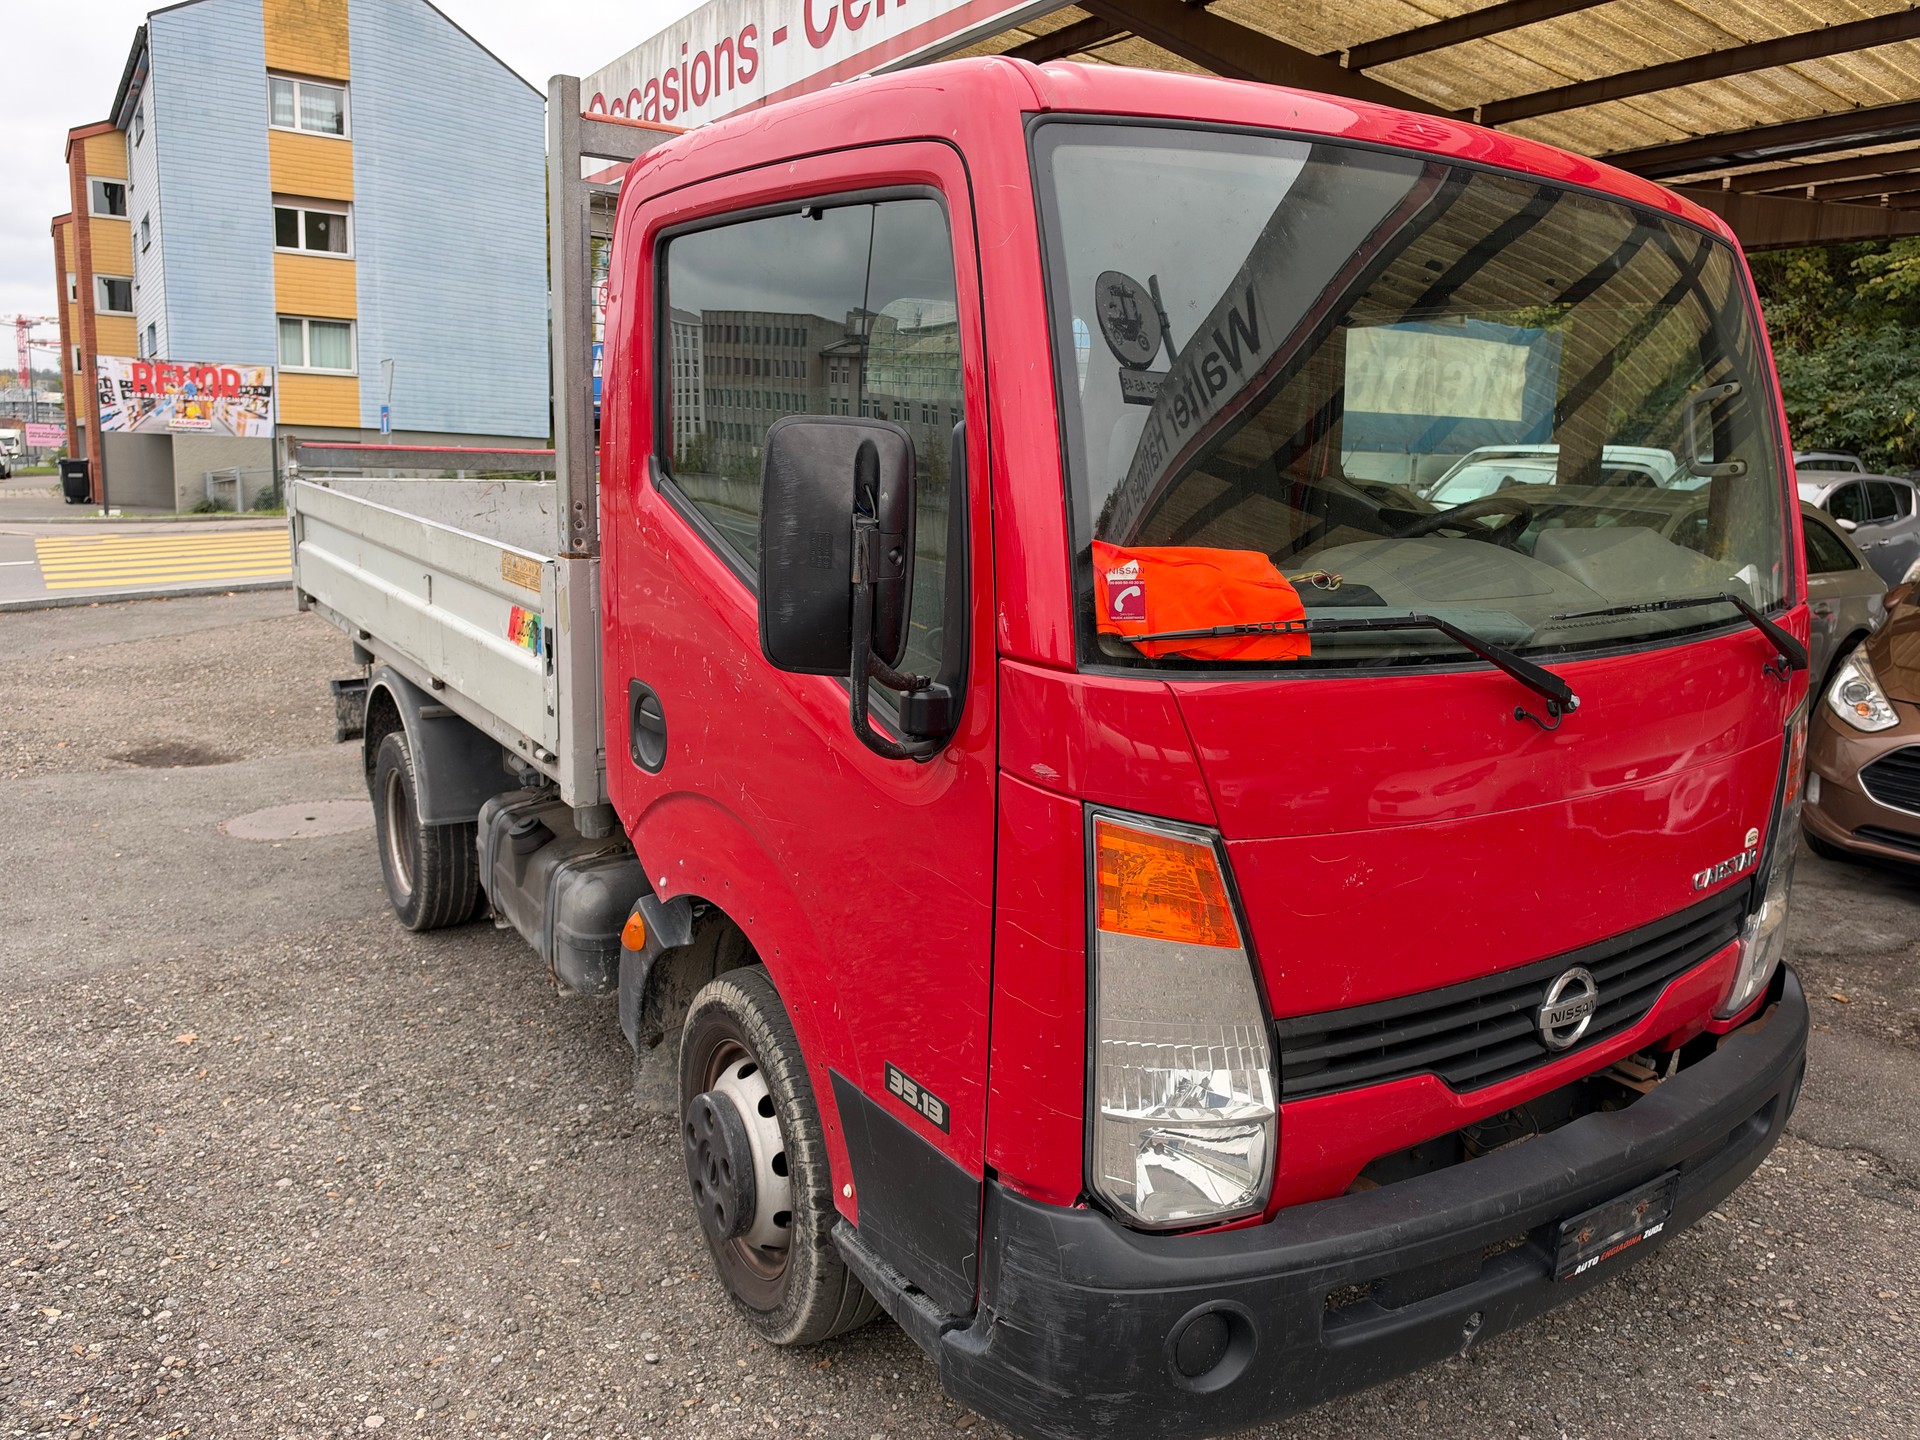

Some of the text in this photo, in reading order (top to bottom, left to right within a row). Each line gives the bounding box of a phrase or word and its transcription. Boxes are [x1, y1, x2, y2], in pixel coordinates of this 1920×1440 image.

[1108, 567, 1145, 575] NISSAN
[1550, 999, 1597, 1025] NISSAN
[889, 1067, 943, 1125] 35.13
[1574, 1255, 1600, 1276] AUTO
